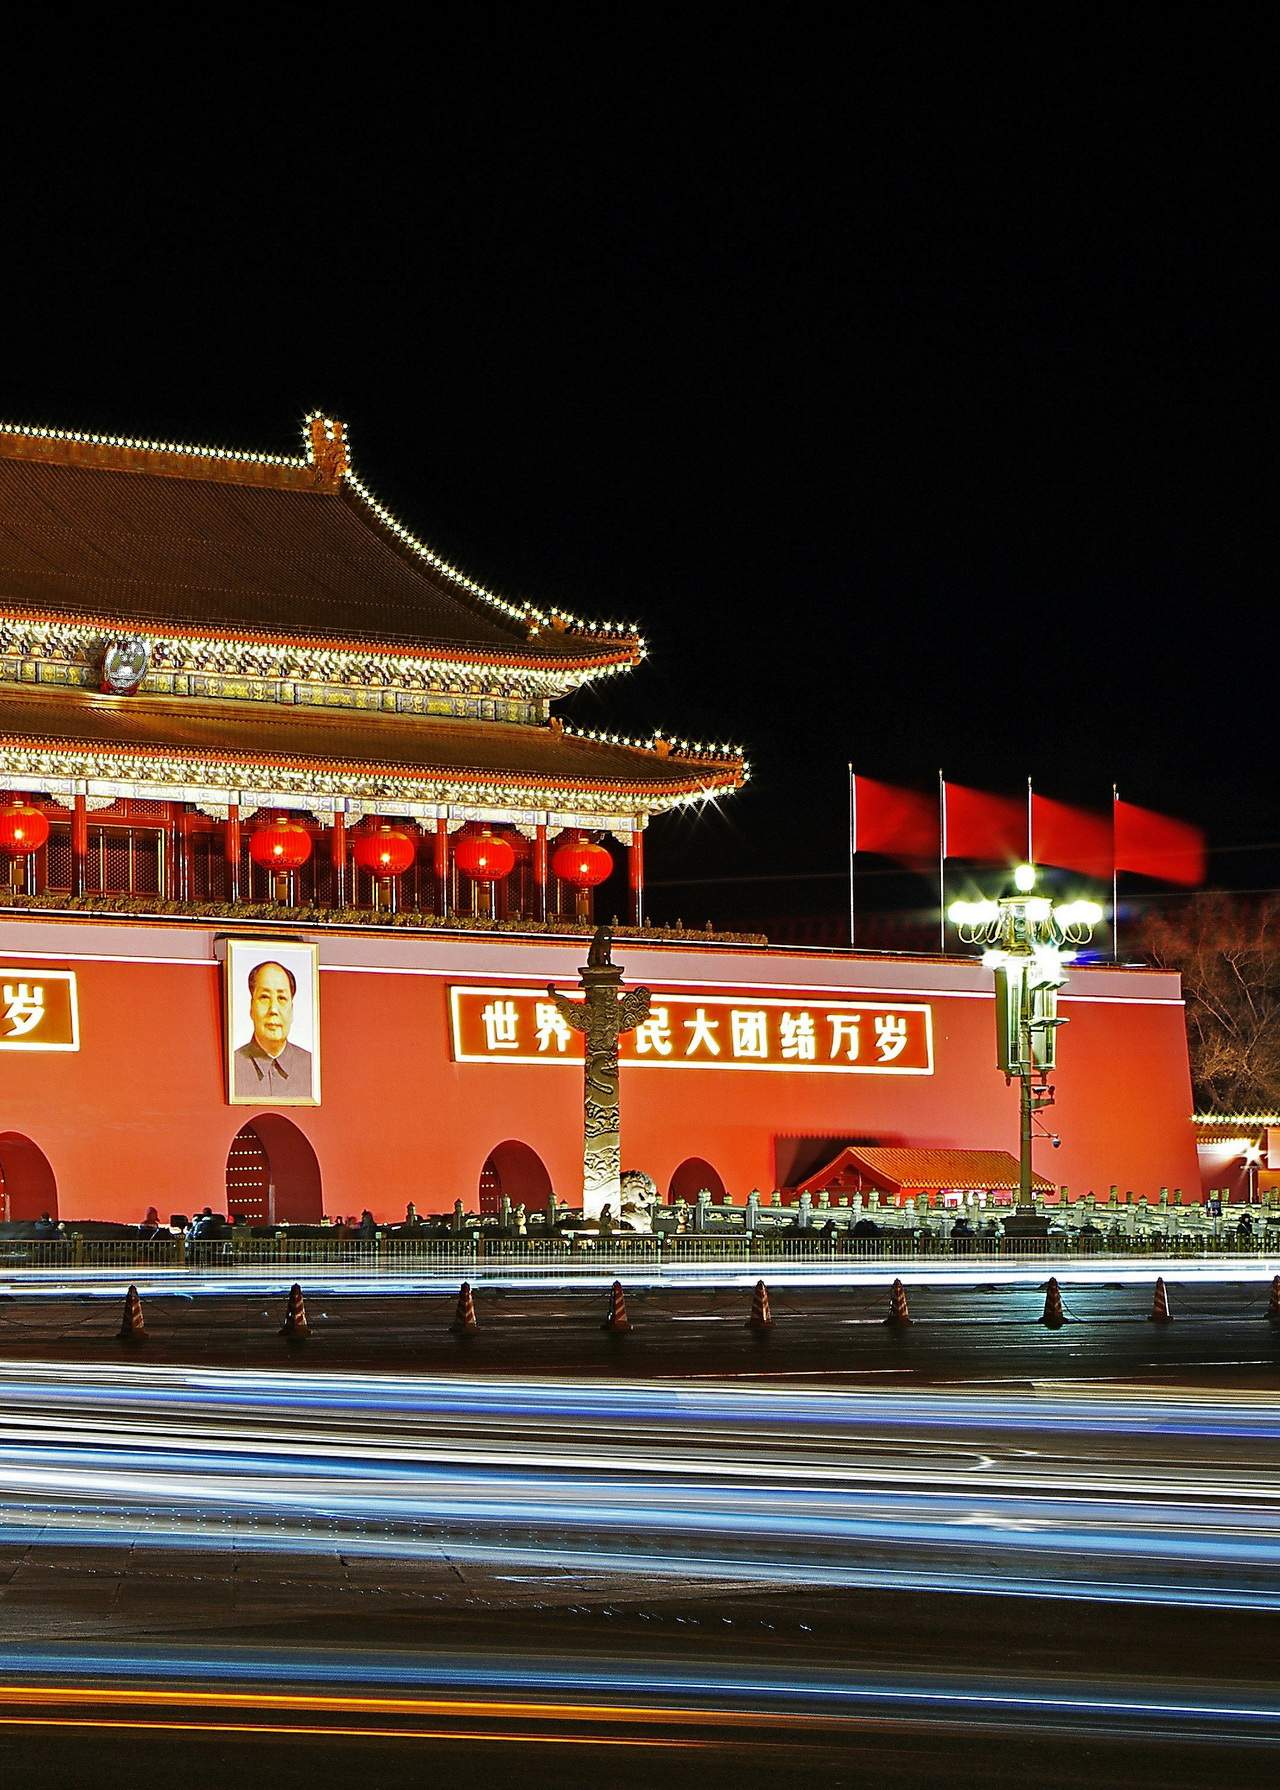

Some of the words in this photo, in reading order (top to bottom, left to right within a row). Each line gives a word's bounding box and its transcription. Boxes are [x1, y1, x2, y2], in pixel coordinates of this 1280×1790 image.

[480, 1000, 908, 1063] 世界民大团结万岁
